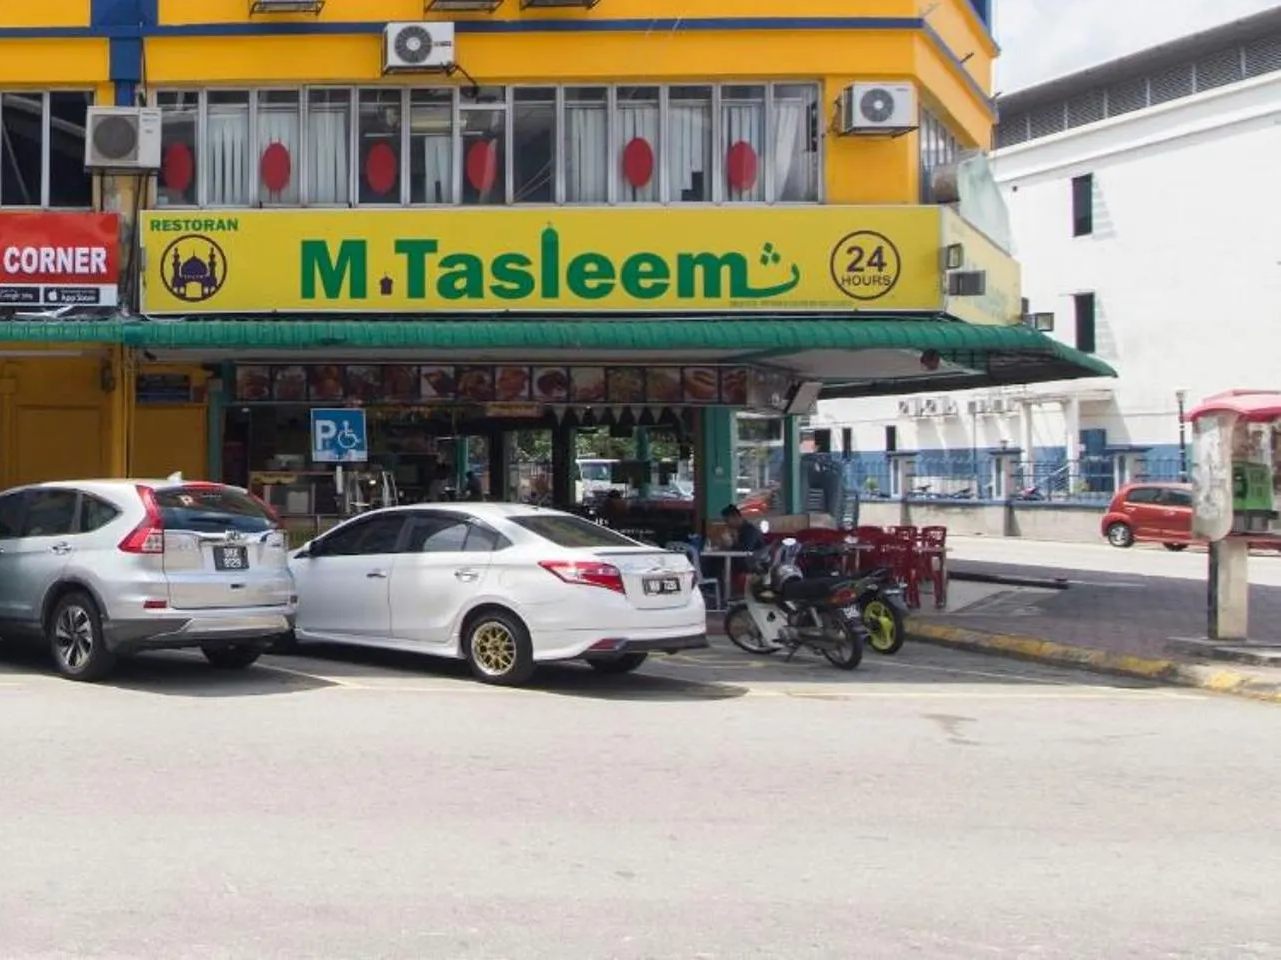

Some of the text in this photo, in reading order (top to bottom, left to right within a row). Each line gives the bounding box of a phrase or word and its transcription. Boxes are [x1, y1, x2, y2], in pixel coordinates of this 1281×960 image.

[150, 218, 239, 232] RESTORAN
[3, 246, 106, 274] CORNER
[847, 245, 887, 272] 24
[842, 275, 891, 286] HOURS
[315, 419, 337, 450] P
